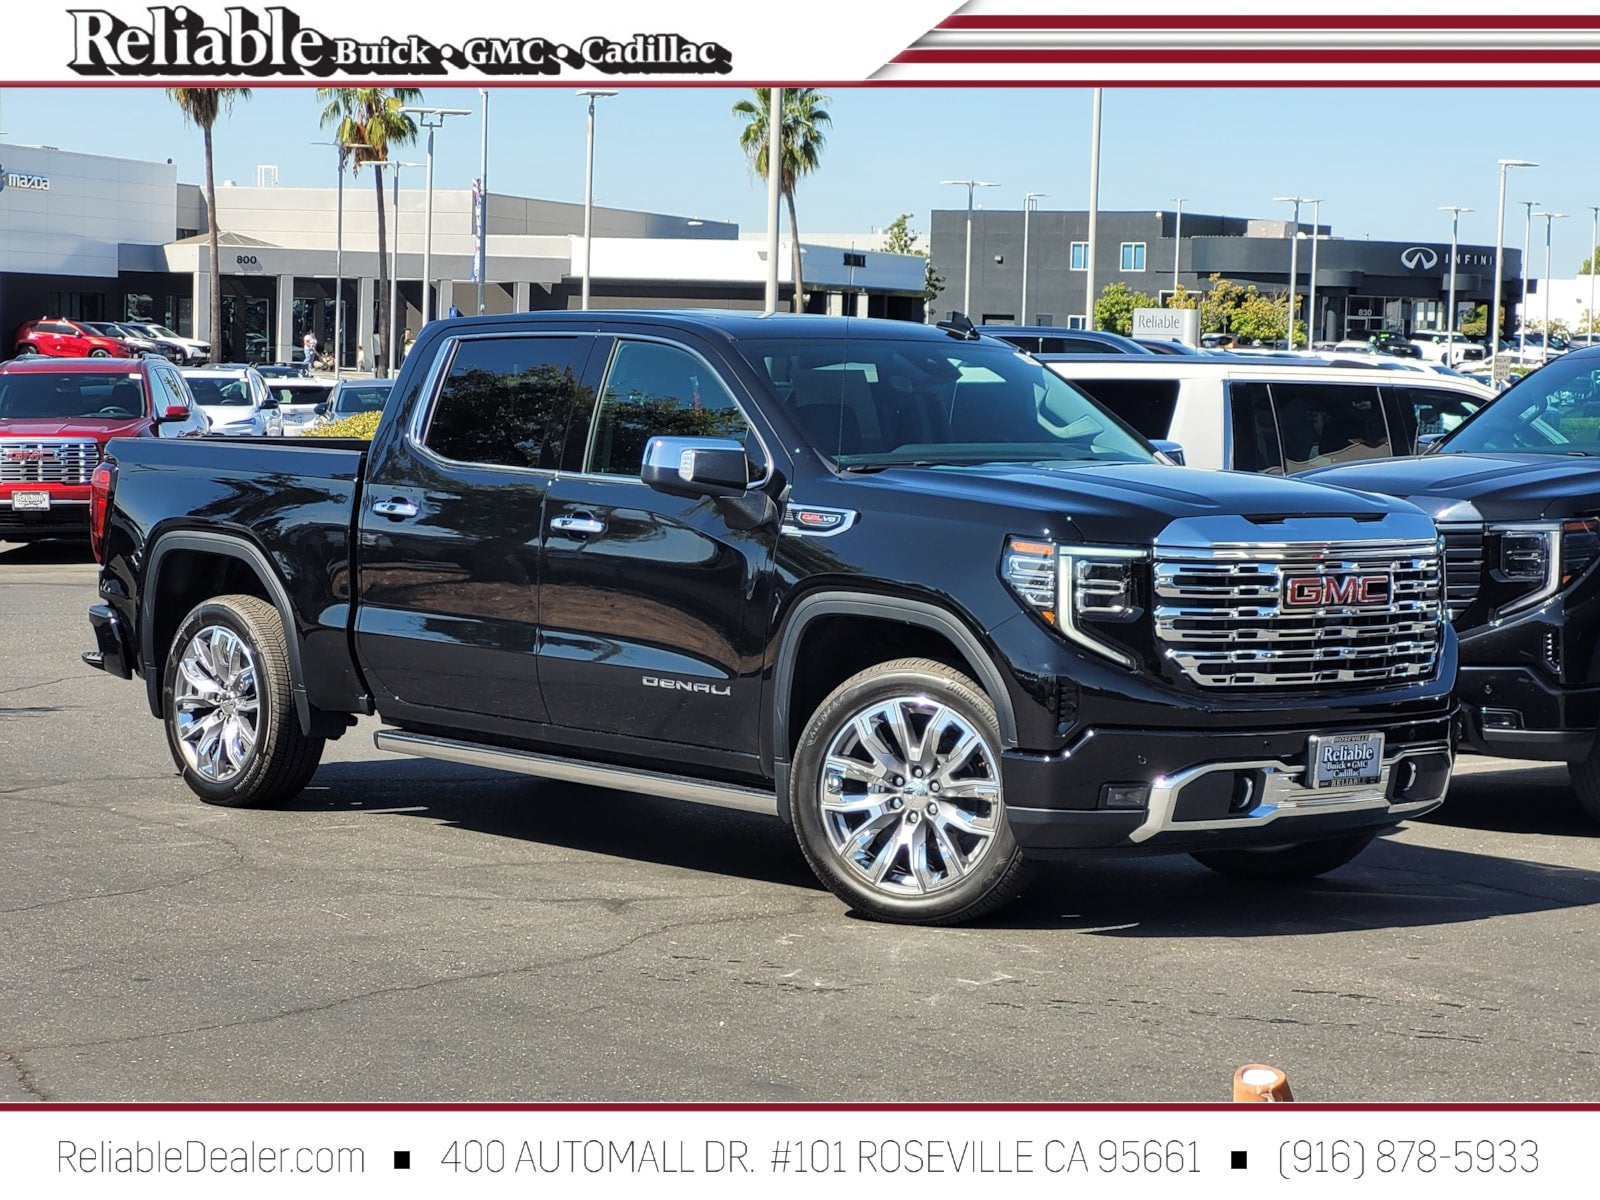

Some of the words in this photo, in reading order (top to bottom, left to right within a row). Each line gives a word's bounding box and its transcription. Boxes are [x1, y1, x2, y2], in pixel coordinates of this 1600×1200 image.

[236, 256, 257, 264] 800
[1138, 315, 1180, 328] Reliable
[1287, 576, 1389, 604] GMC
[642, 676, 731, 696] DENALI
[1323, 744, 1374, 762] Reliable
[1327, 761, 1346, 770] Buick
[1333, 768, 1360, 778] Cadillac
